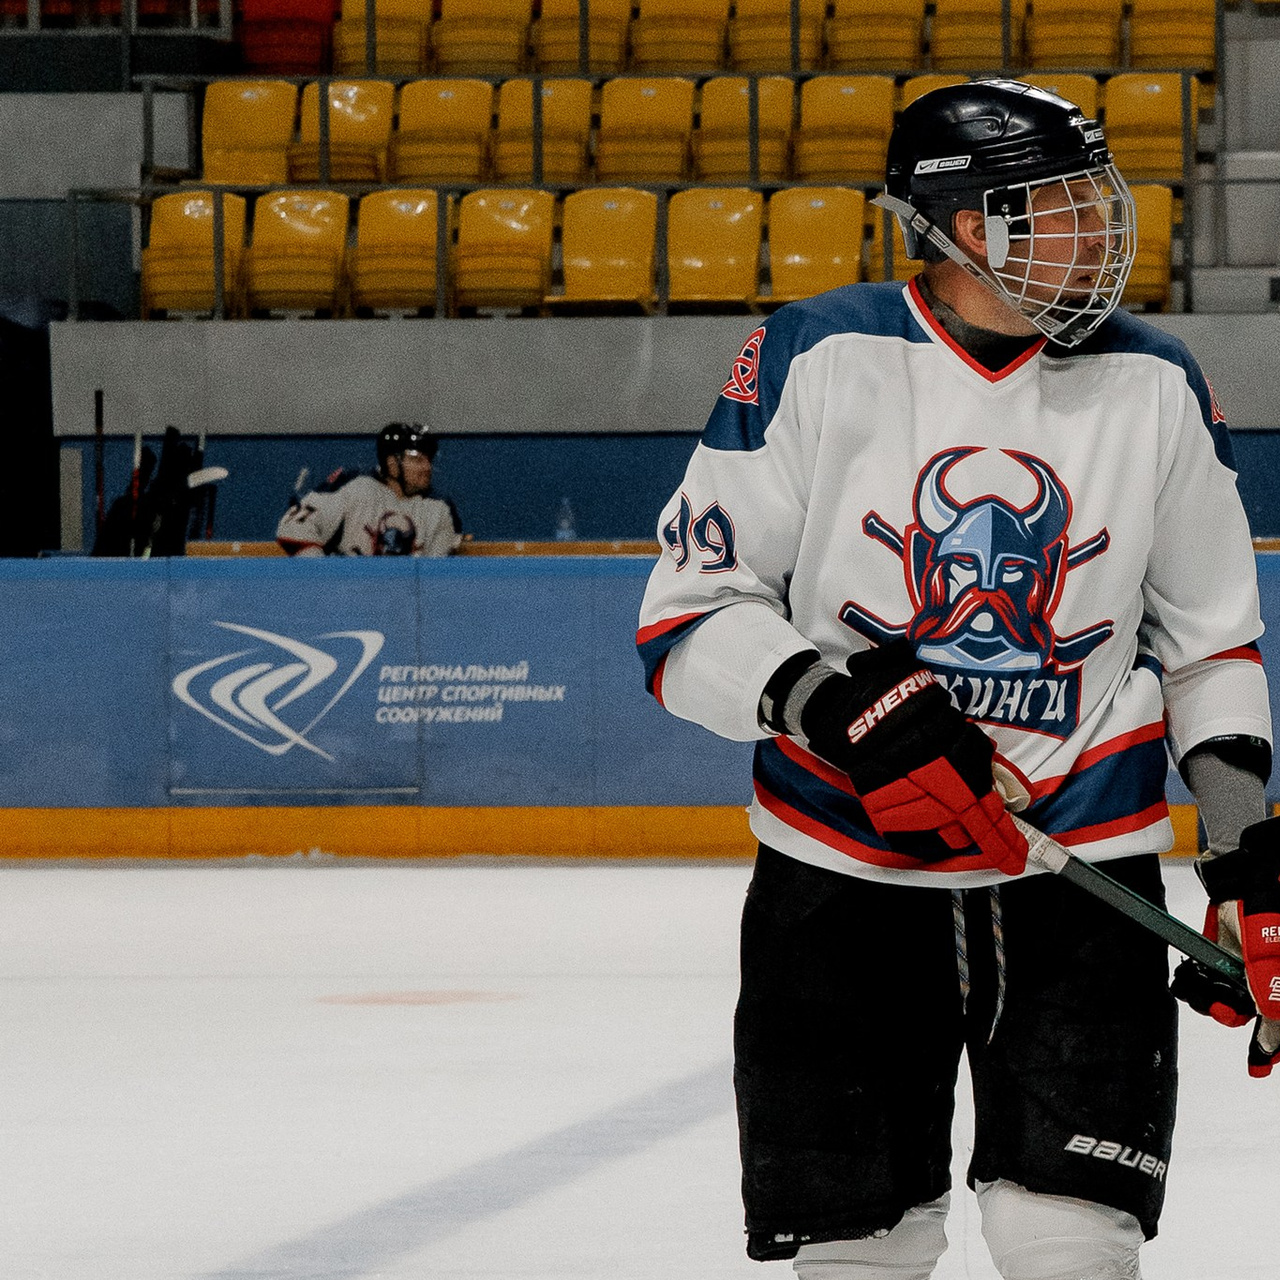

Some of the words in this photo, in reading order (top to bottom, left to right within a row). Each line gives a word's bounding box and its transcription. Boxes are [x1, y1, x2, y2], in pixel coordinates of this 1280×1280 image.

[379, 660, 529, 682] РЕГИОНАЛЬНЫЙ
[378, 685, 439, 703] ЦЕНТР
[441, 685, 566, 702] СПОРТИВНЫХ
[848, 670, 938, 744] SHERW
[934, 673, 1067, 722] КИНГИ
[375, 702, 503, 723] СООРУЖЕНИЙ
[1064, 1133, 1167, 1182] BAUER
